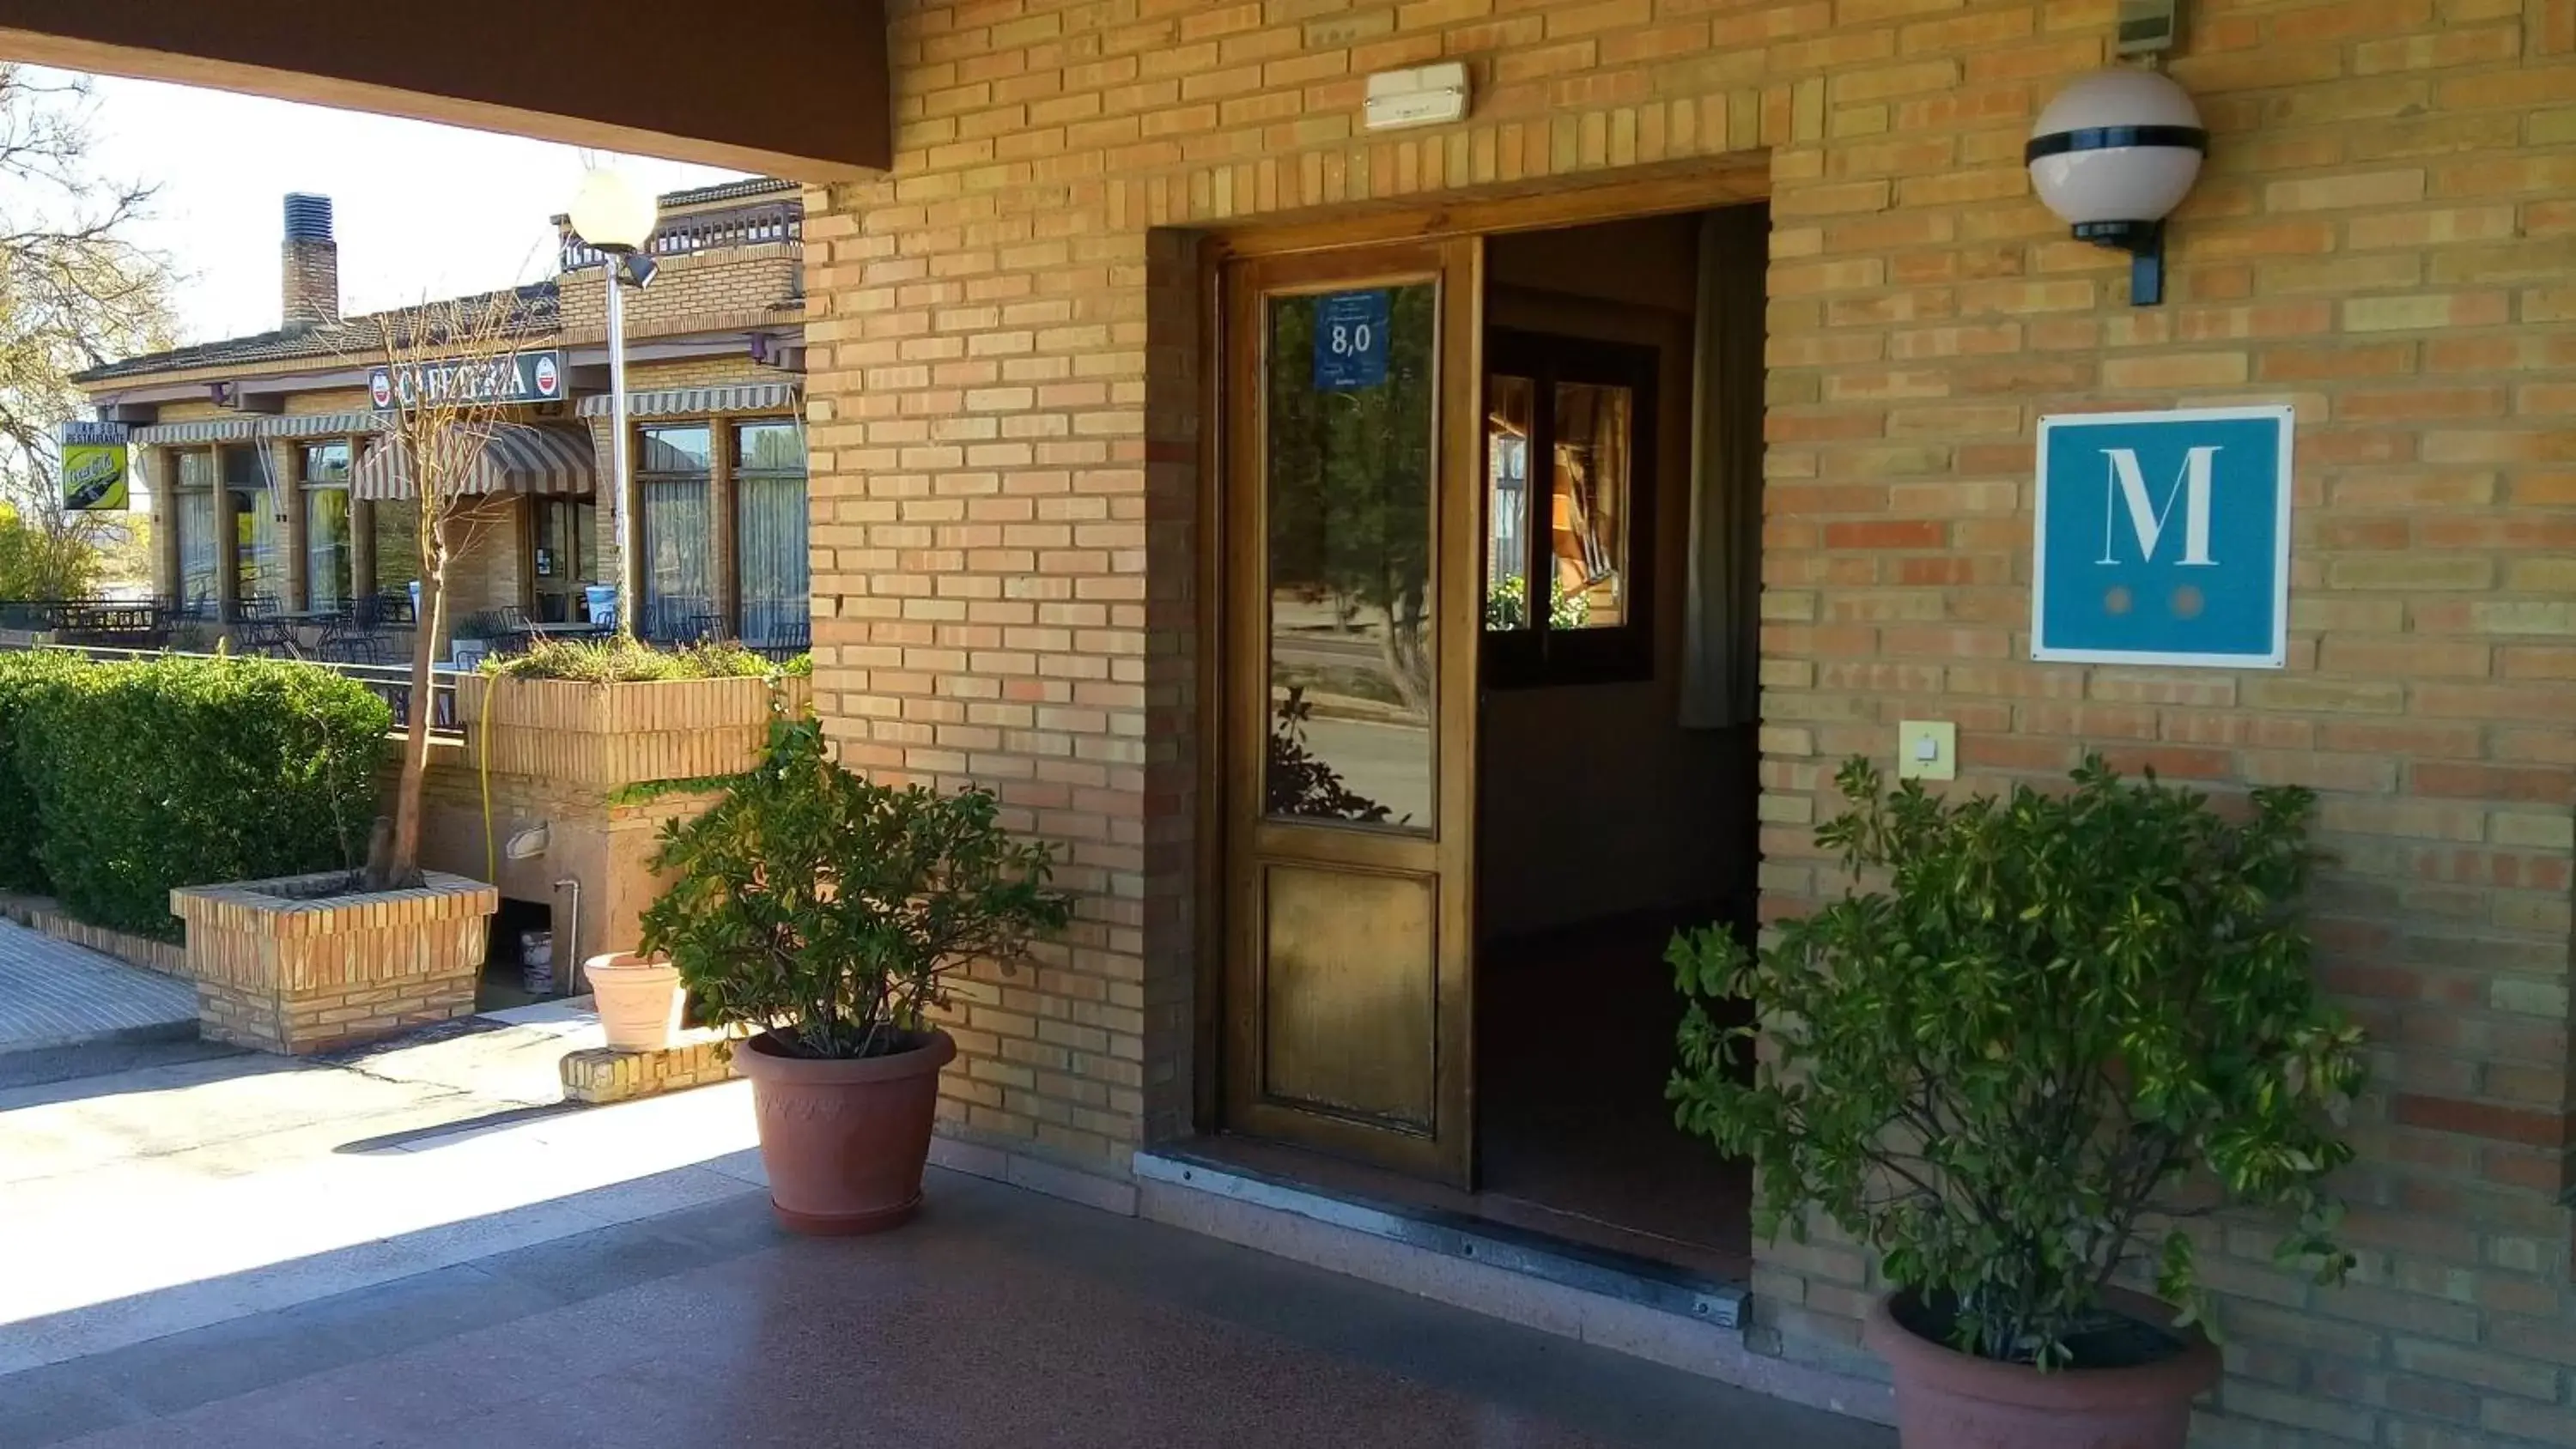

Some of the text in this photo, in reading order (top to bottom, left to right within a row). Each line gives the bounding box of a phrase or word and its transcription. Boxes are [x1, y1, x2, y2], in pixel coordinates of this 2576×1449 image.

[1333, 324, 1370, 357] 8,0
[67, 433, 125, 444] RESTAURANTE
[2095, 446, 2223, 566] M
